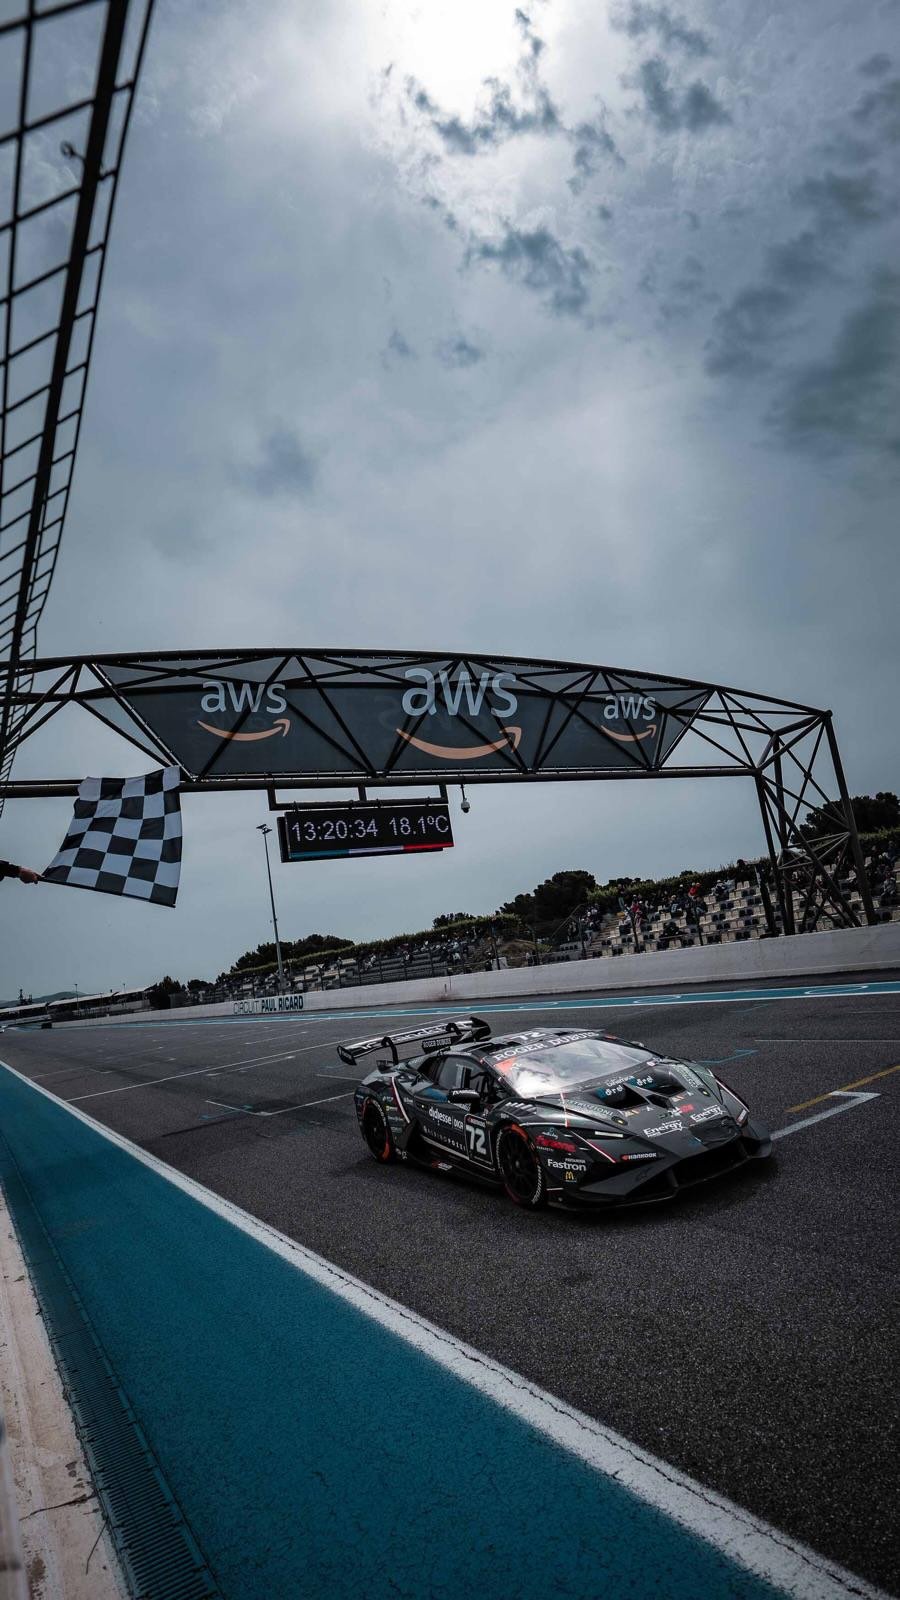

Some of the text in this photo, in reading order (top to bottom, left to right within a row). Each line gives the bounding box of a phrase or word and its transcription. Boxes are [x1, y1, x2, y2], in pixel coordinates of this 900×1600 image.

[201, 681, 287, 713] aws
[402, 668, 518, 718] aws
[603, 695, 656, 720] aws
[291, 820, 379, 842] 13:20:34
[261, 999, 277, 1013] PAUL
[278, 995, 304, 1011] RICARD
[494, 1042, 548, 1061] ROGER
[643, 1120, 683, 1137] Energy
[465, 1124, 488, 1156] 72
[547, 1158, 587, 1172] Fastron
